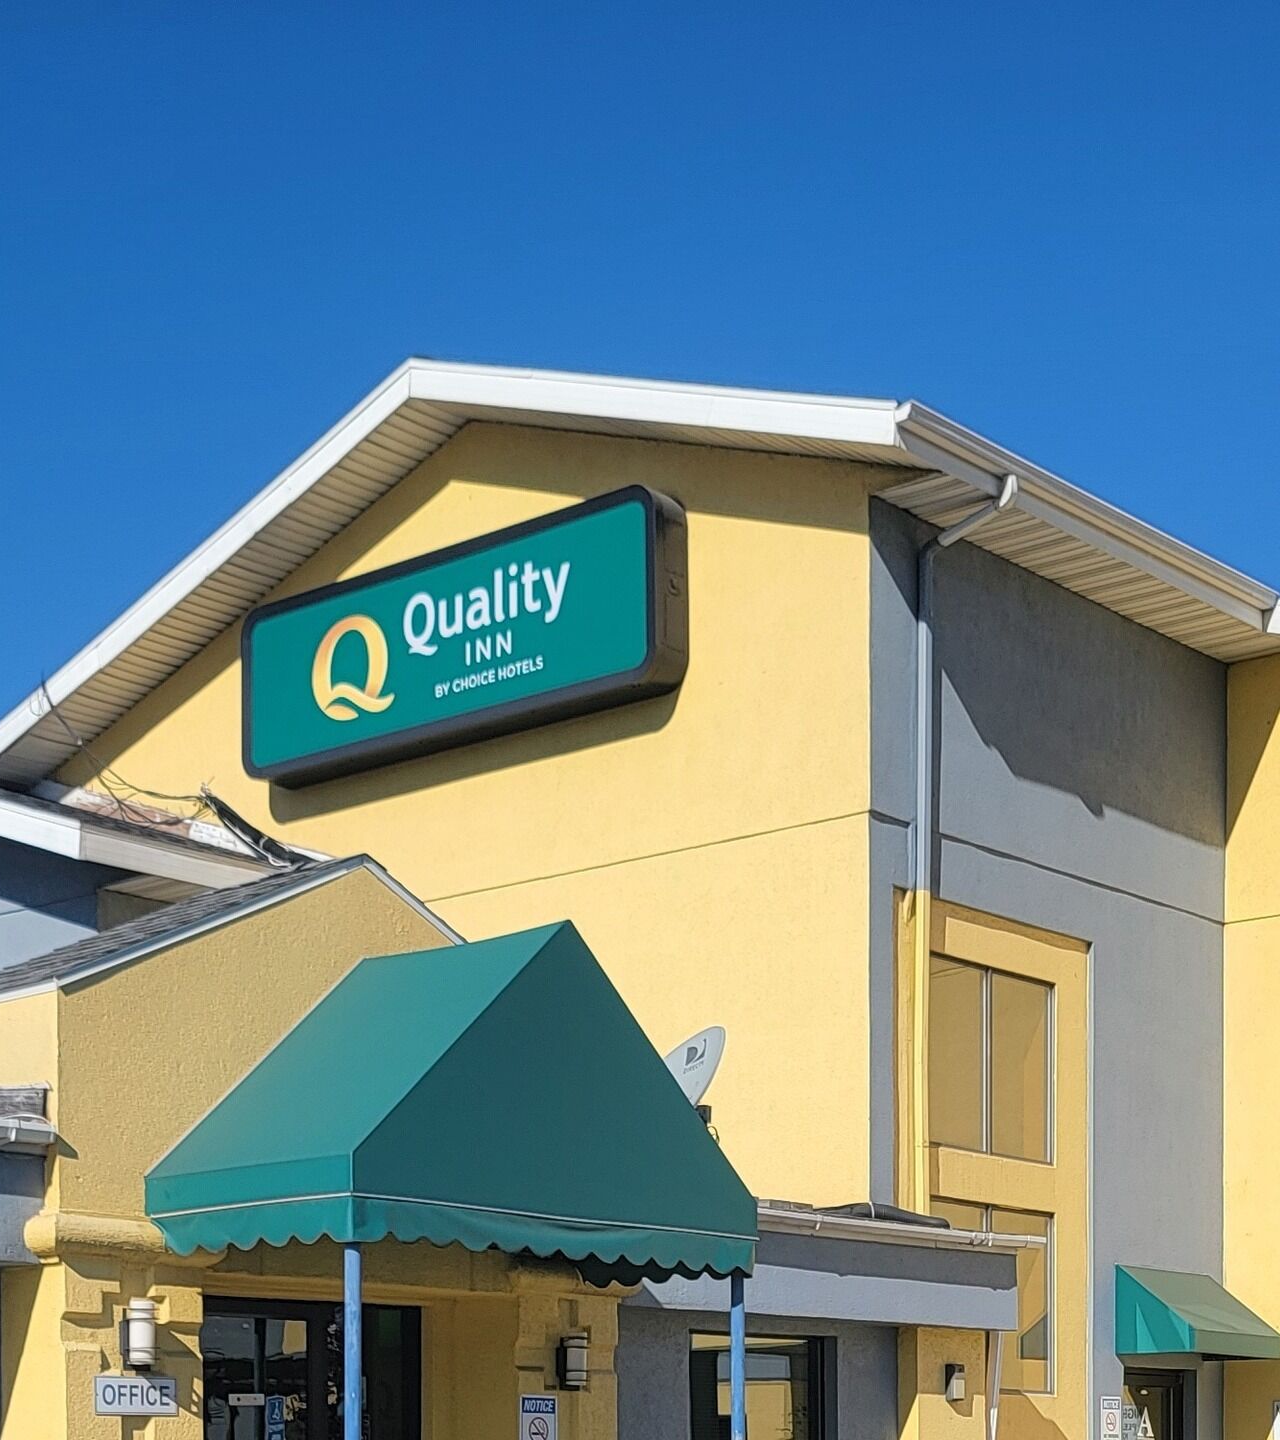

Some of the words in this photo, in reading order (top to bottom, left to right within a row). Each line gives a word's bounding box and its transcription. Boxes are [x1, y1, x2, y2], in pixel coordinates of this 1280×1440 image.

[402, 561, 570, 656] Quality
[465, 629, 512, 666] INN
[311, 614, 395, 721] Q
[434, 681, 450, 698] BY
[452, 668, 496, 693] CHOICE
[497, 654, 544, 681] HOTELS
[102, 1384, 170, 1406] OFFICE
[523, 1399, 554, 1412] NOTICE
[1137, 1406, 1154, 1436] A
